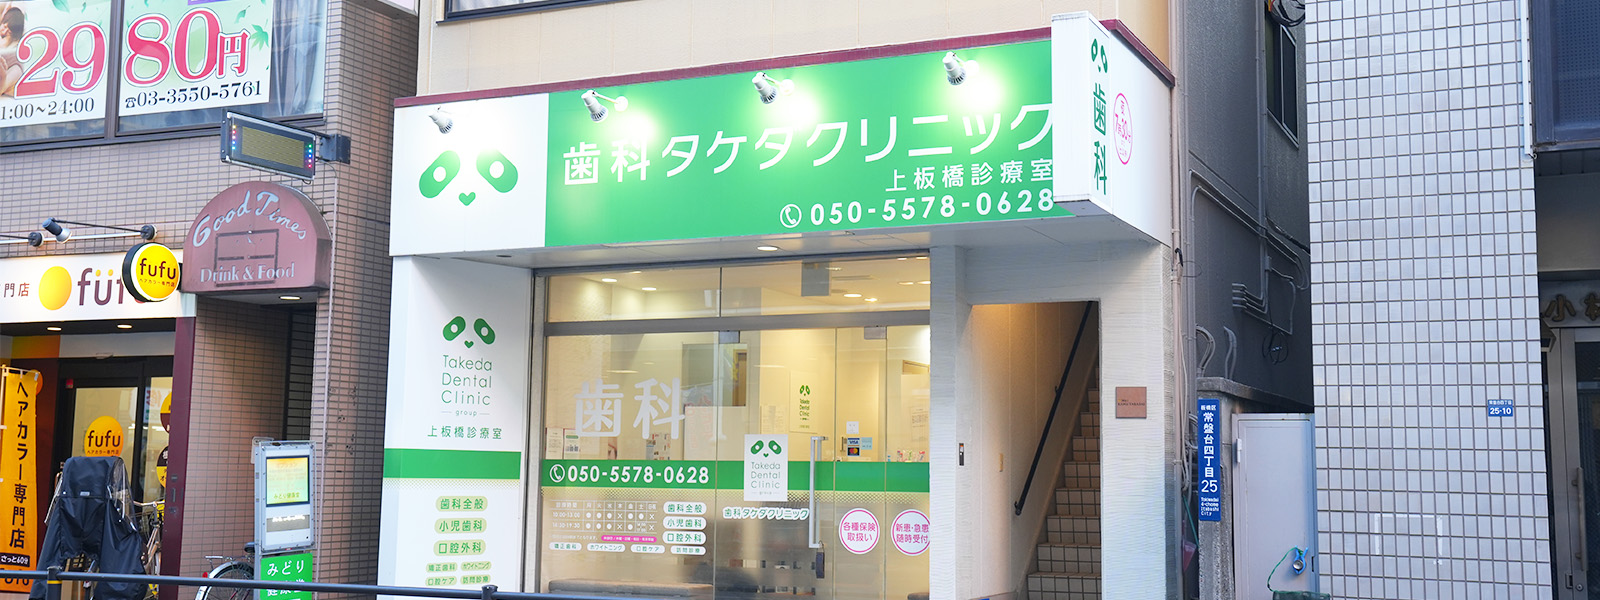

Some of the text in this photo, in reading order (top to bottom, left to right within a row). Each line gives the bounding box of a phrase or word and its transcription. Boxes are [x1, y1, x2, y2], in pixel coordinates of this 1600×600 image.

[562, 103, 1054, 186] 歯科タケダクリニック
[1093, 82, 1108, 196] 歯科
[885, 157, 1054, 192] 上板橋診療室
[810, 188, 1054, 226] 050-5578-0628
[192, 190, 307, 248] Good Times
[200, 265, 241, 283] Drink
[257, 262, 296, 280] Food
[443, 354, 493, 372] Takeda
[441, 372, 492, 389] Dental
[441, 389, 491, 406] Clinic
[455, 409, 477, 418] group
[574, 377, 687, 440] 歯科
[1490, 407, 1512, 415] 25-10
[427, 424, 503, 440] 上板橋診療室
[567, 464, 710, 484] 050-5578-0628
[751, 461, 781, 470] Takeda
[750, 471, 781, 479] Dental
[750, 480, 781, 489] Clinic
[1201, 480, 1218, 493] 25
[724, 507, 810, 520] 歯科タケダクリニック
[266, 560, 305, 577] みどり
